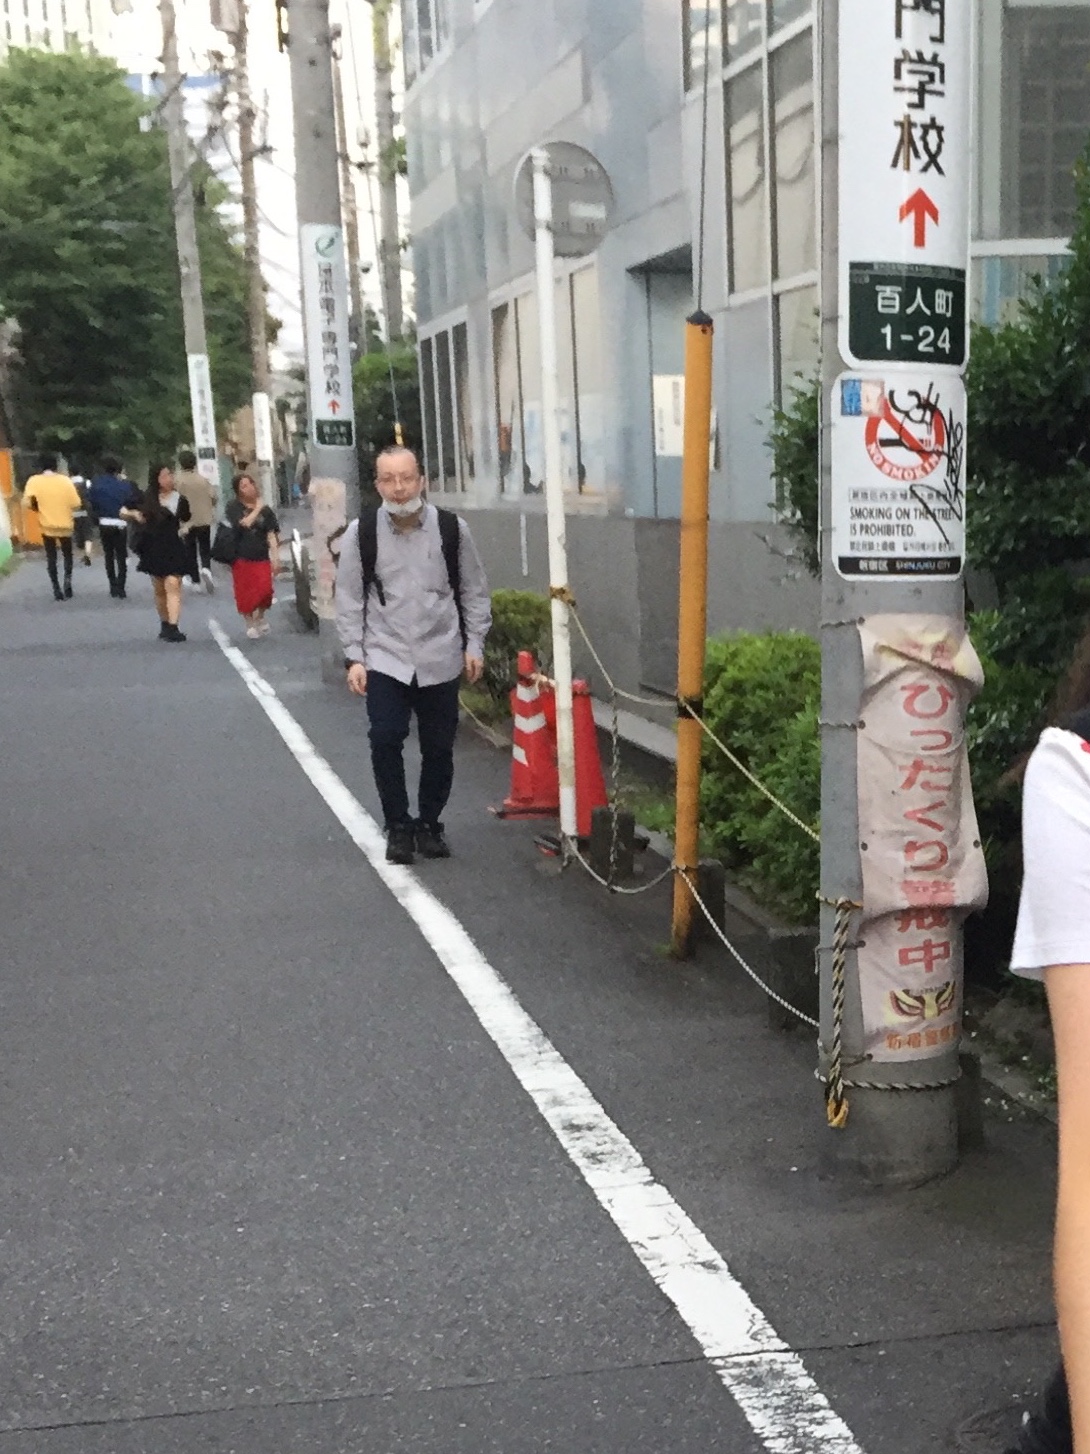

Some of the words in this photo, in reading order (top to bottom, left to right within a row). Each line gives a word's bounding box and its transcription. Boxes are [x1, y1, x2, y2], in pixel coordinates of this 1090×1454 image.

[890, 0, 946, 176] 門学校
[875, 285, 953, 318] 百人町
[881, 322, 951, 355] 1-24
[850, 506, 892, 521] SMOKING
[895, 507, 911, 521] ON
[850, 523, 857, 537] IS
